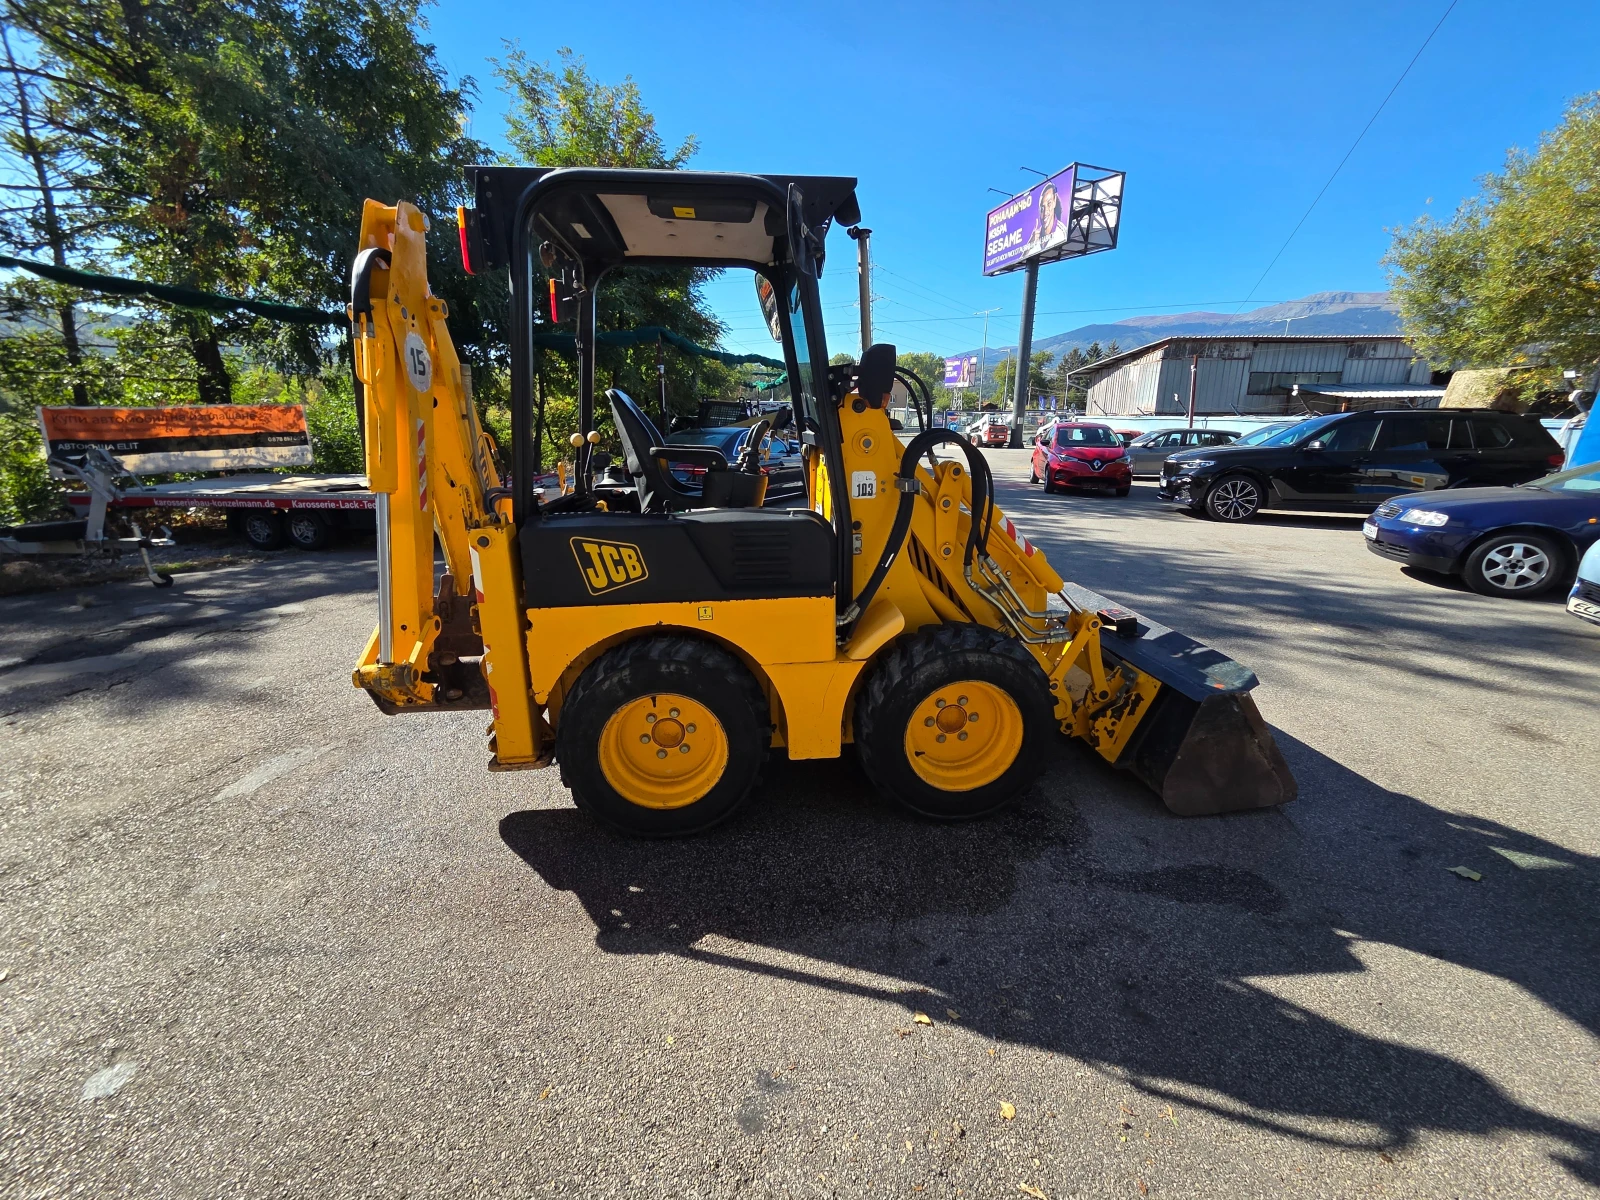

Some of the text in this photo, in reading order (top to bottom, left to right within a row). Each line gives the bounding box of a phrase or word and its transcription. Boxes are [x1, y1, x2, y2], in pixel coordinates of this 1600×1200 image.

[987, 227, 1023, 257] SESAME
[410, 347, 426, 376] 15
[51, 414, 88, 425] Купи
[117, 442, 140, 450] ELIT
[856, 482, 873, 497] 103
[153, 498, 275, 508] karosseriebau-konzelmann.de
[582, 542, 643, 589] JCB
